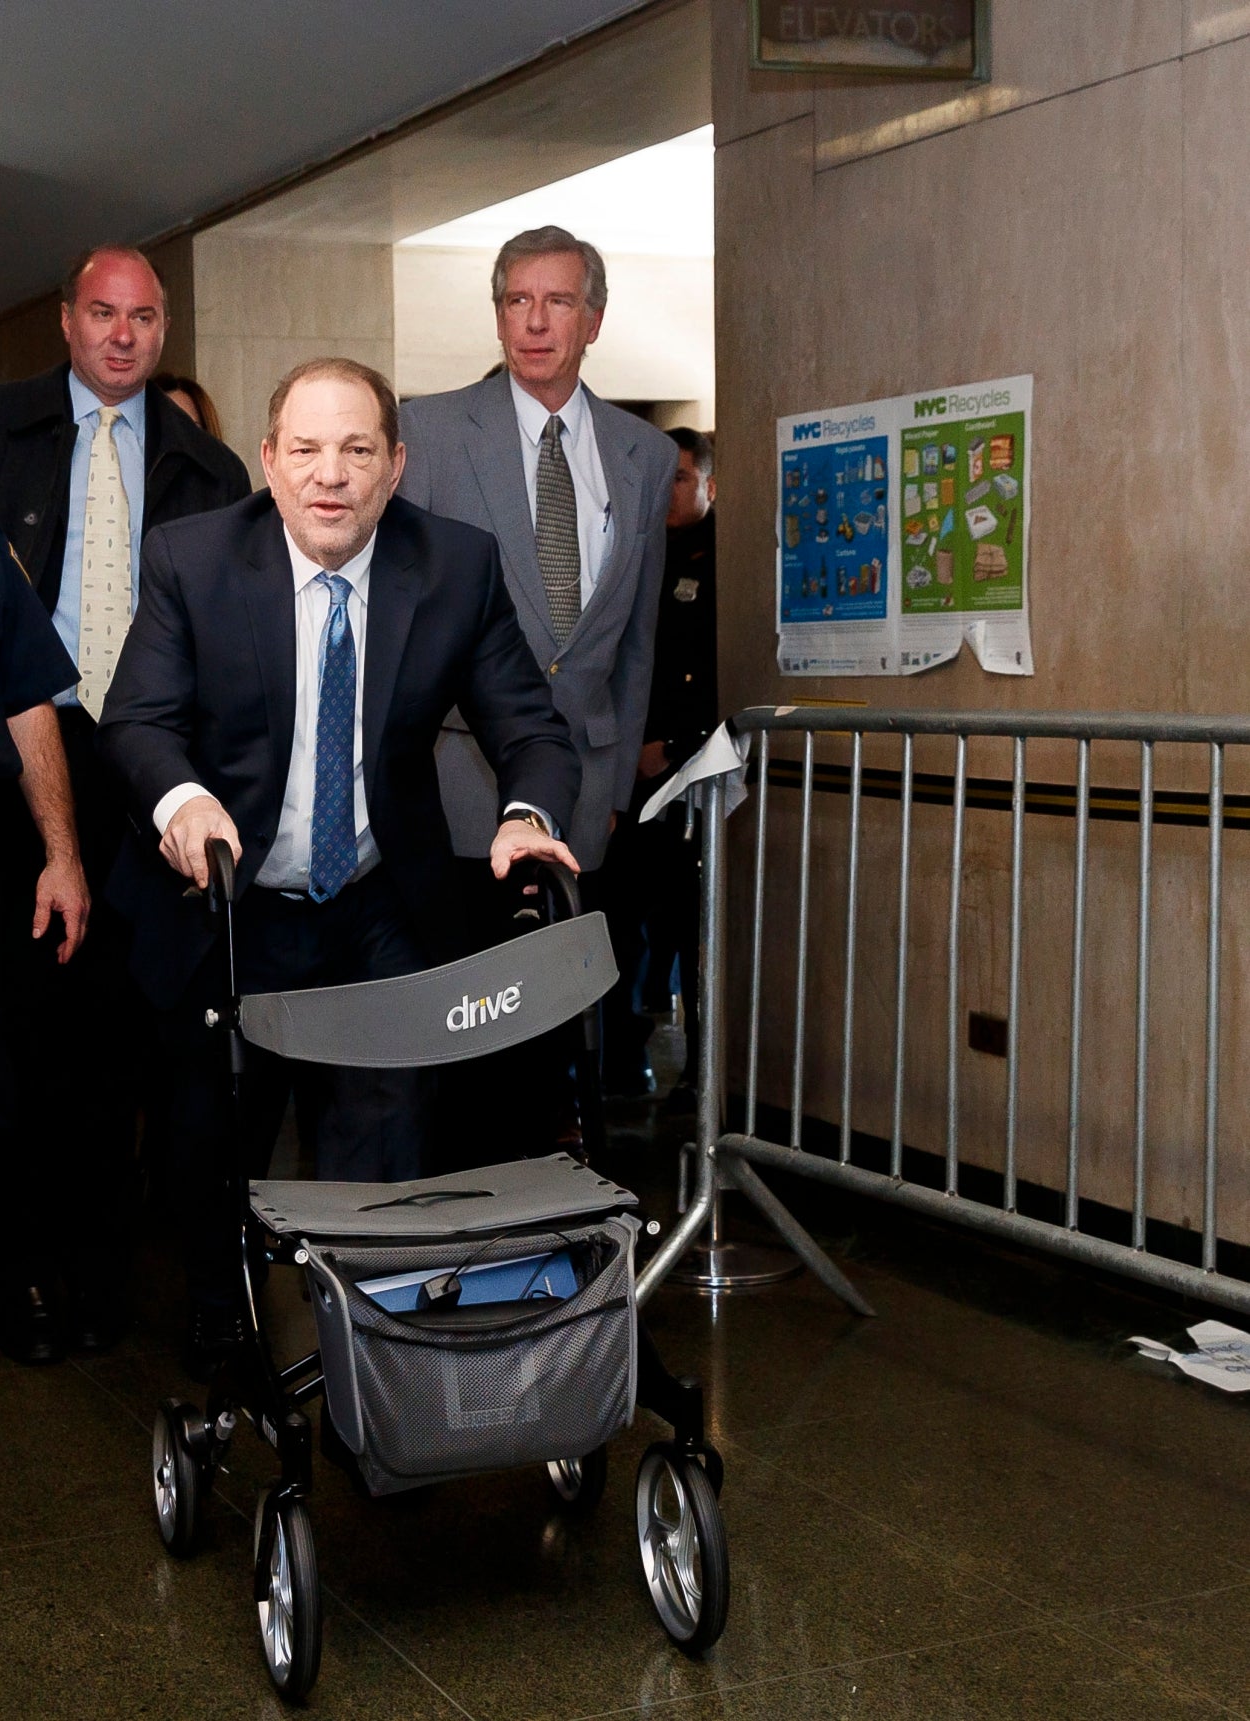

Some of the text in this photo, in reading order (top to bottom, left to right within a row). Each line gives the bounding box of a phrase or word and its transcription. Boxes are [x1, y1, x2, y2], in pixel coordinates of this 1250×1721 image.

[779, 6, 955, 47] ELEVATORS
[914, 390, 1011, 419] NYC Recycles
[792, 415, 876, 442] NYC Recycles
[446, 986, 521, 1033] drive
